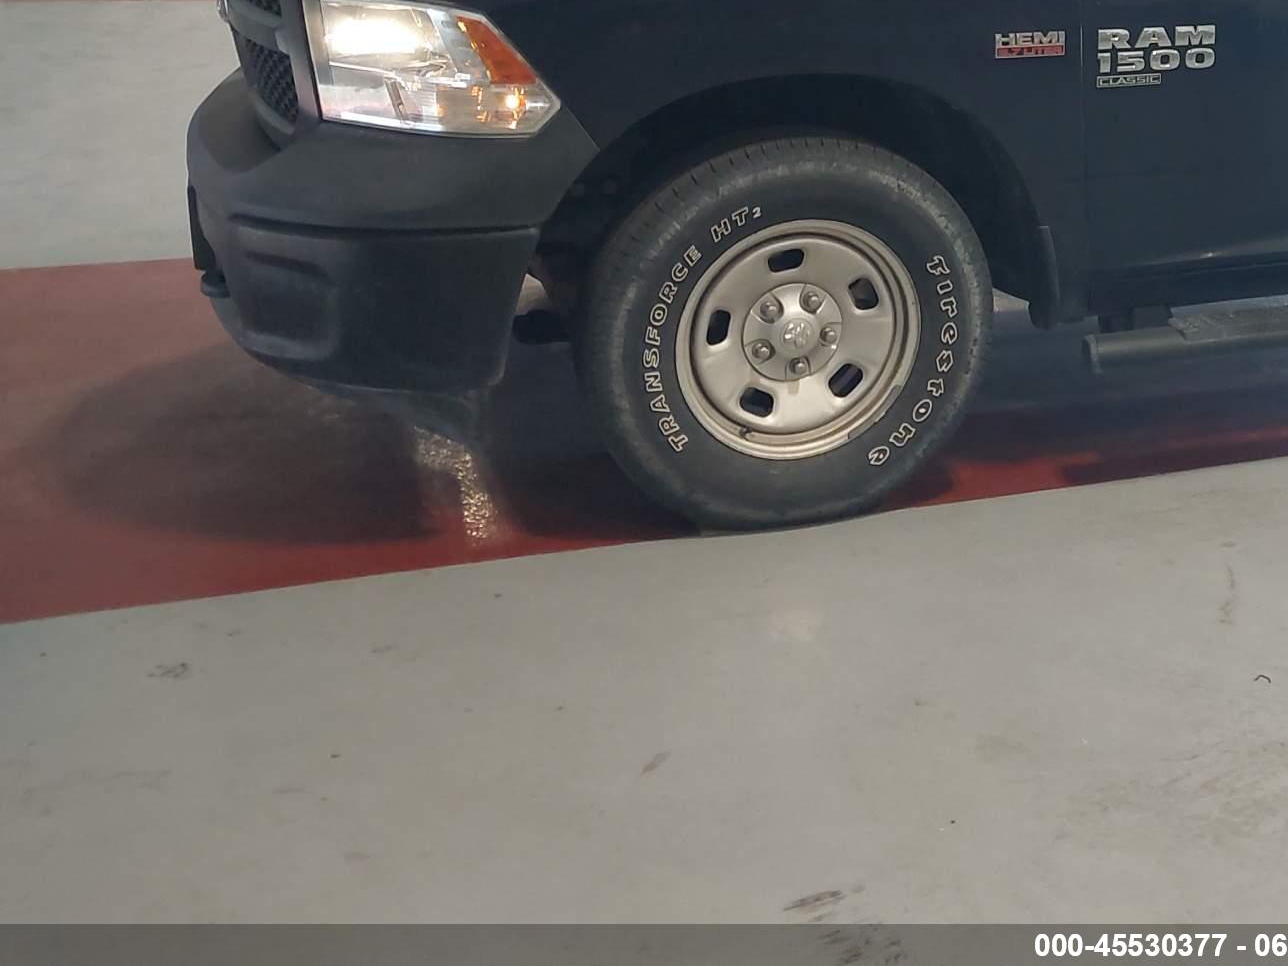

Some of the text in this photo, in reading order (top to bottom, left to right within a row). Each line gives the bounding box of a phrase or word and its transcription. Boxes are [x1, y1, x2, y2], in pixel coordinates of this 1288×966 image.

[995, 31, 1065, 47] HEMI
[1098, 25, 1216, 50] RAM
[1097, 48, 1216, 73] 1500
[1099, 74, 1160, 87] CLASSIC
[643, 245, 703, 452] TRANSFORCE
[868, 254, 958, 466] Firestone
